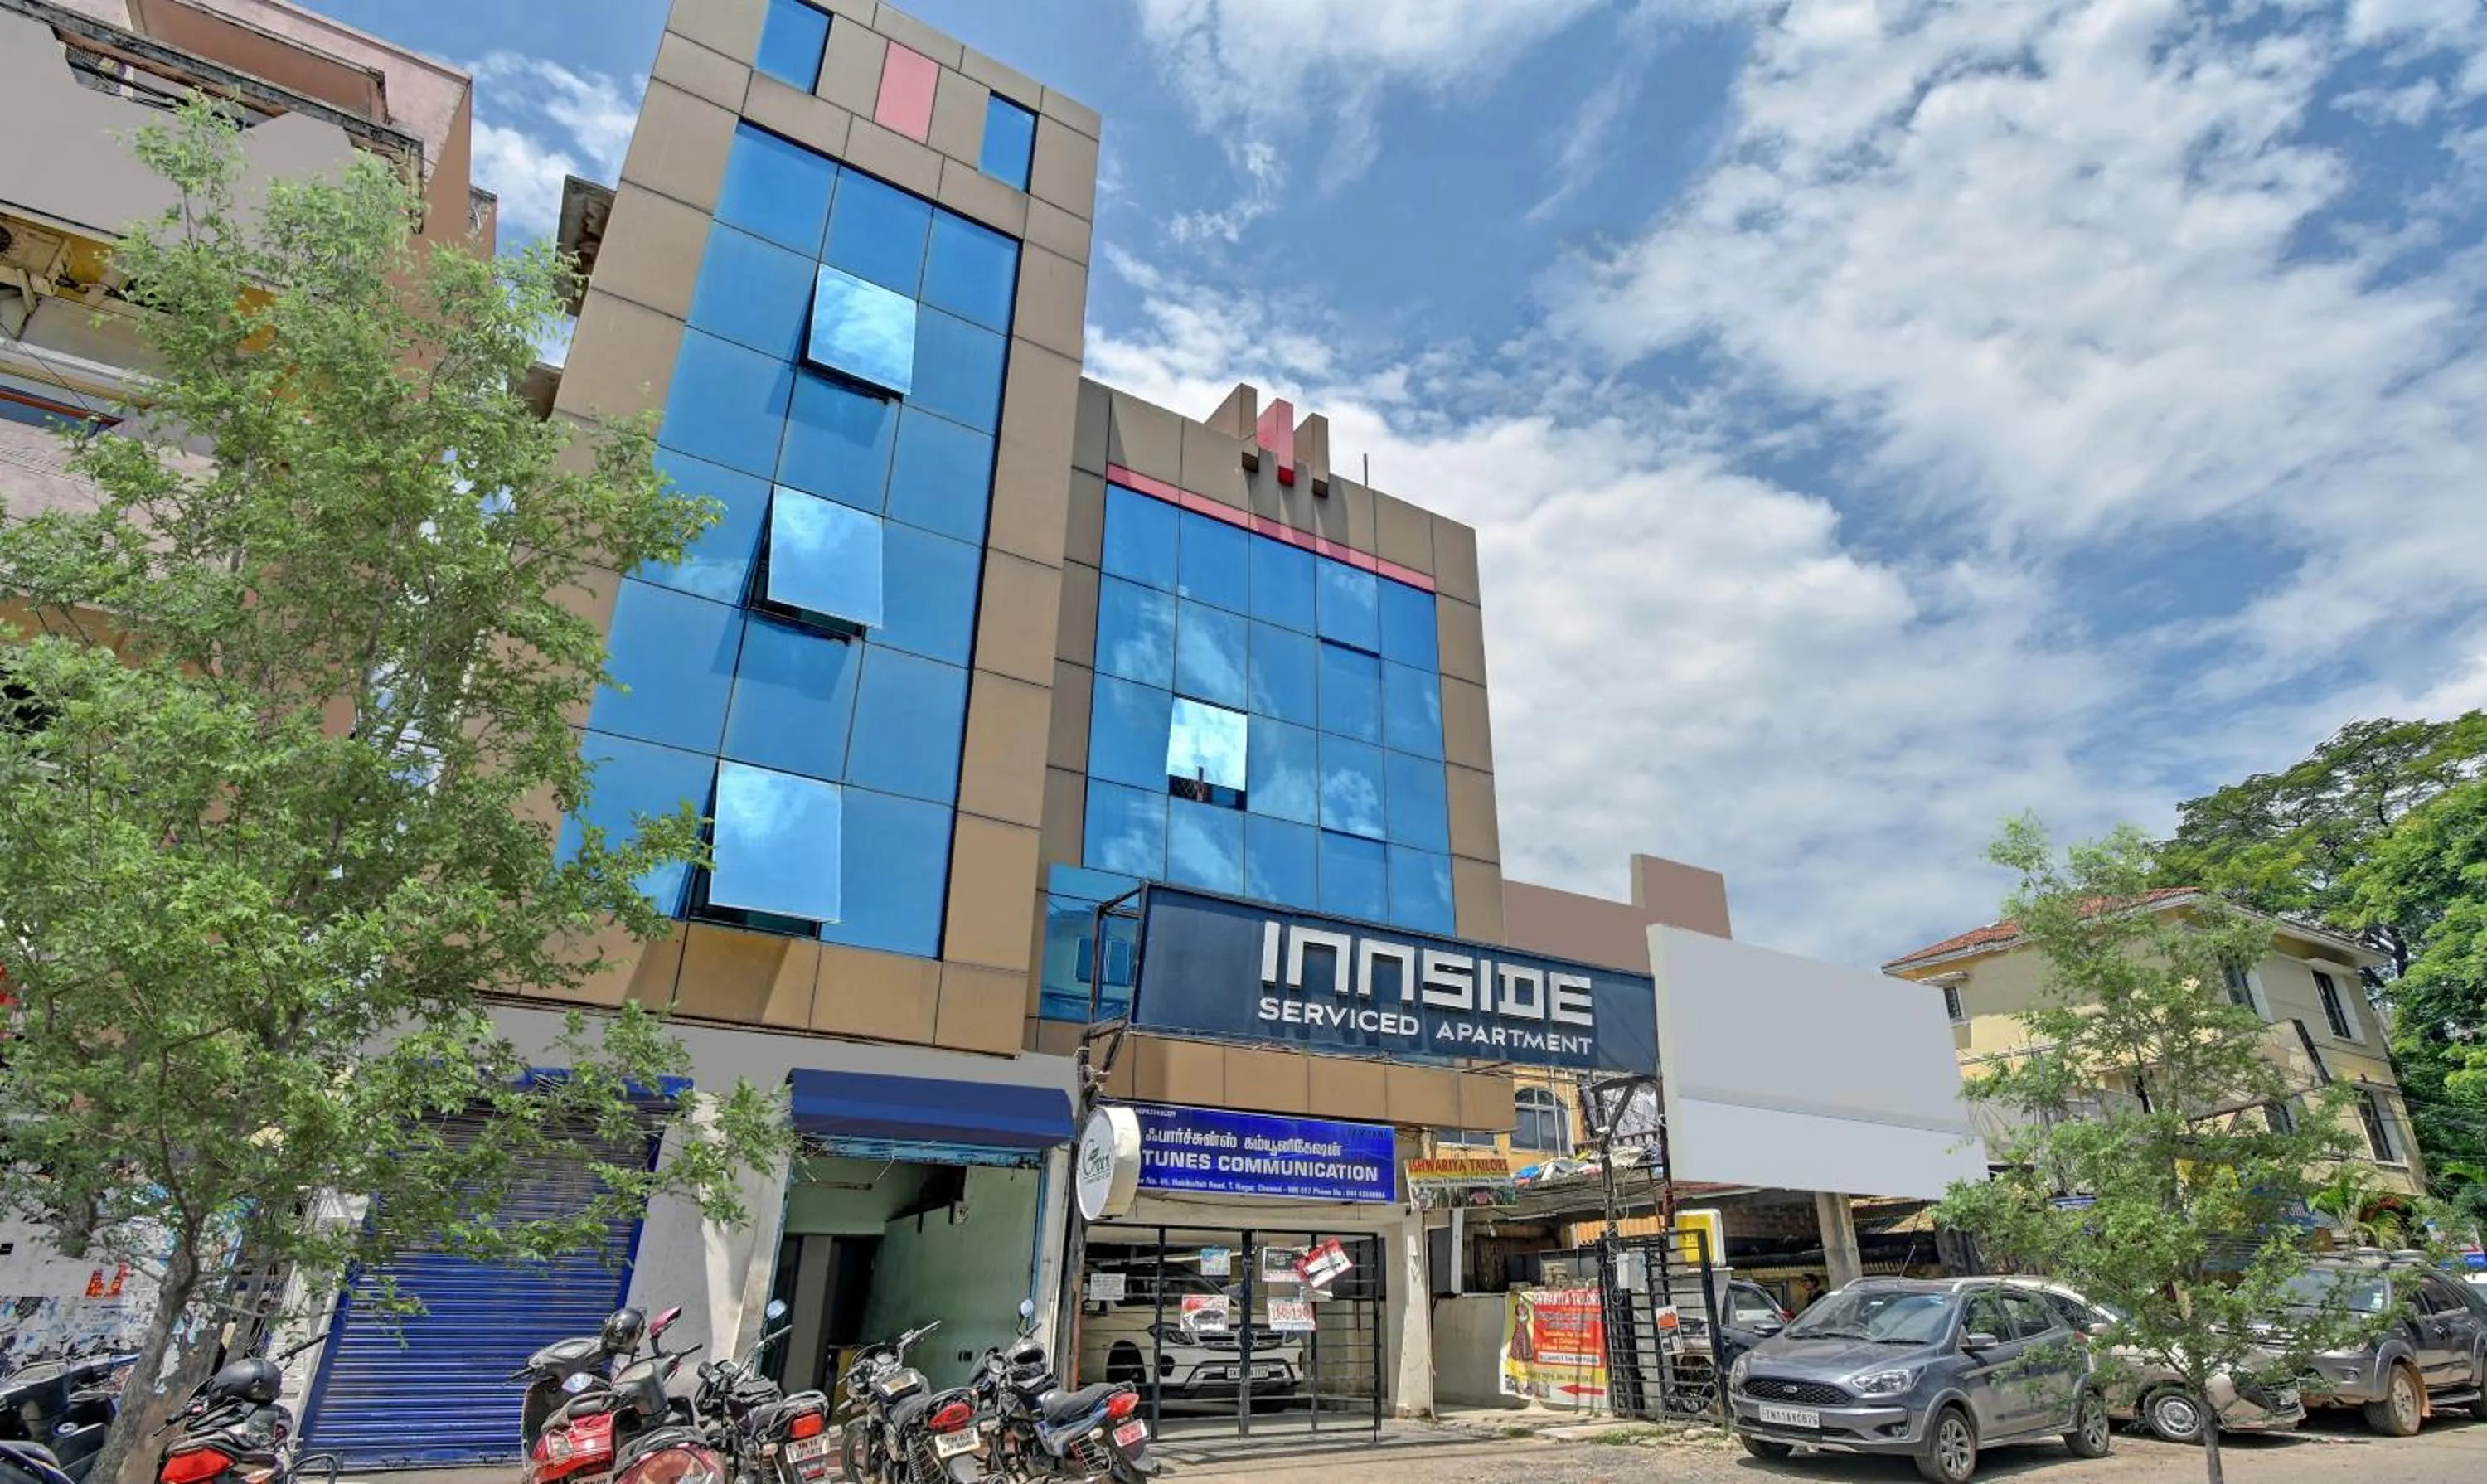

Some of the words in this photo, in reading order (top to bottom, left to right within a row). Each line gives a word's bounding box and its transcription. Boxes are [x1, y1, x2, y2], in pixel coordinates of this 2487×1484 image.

[1258, 997, 1419, 1035] SERVICED
[1435, 1021, 1593, 1055] APARTMENT
[1218, 1155, 1379, 1181] COMMUNICATION
